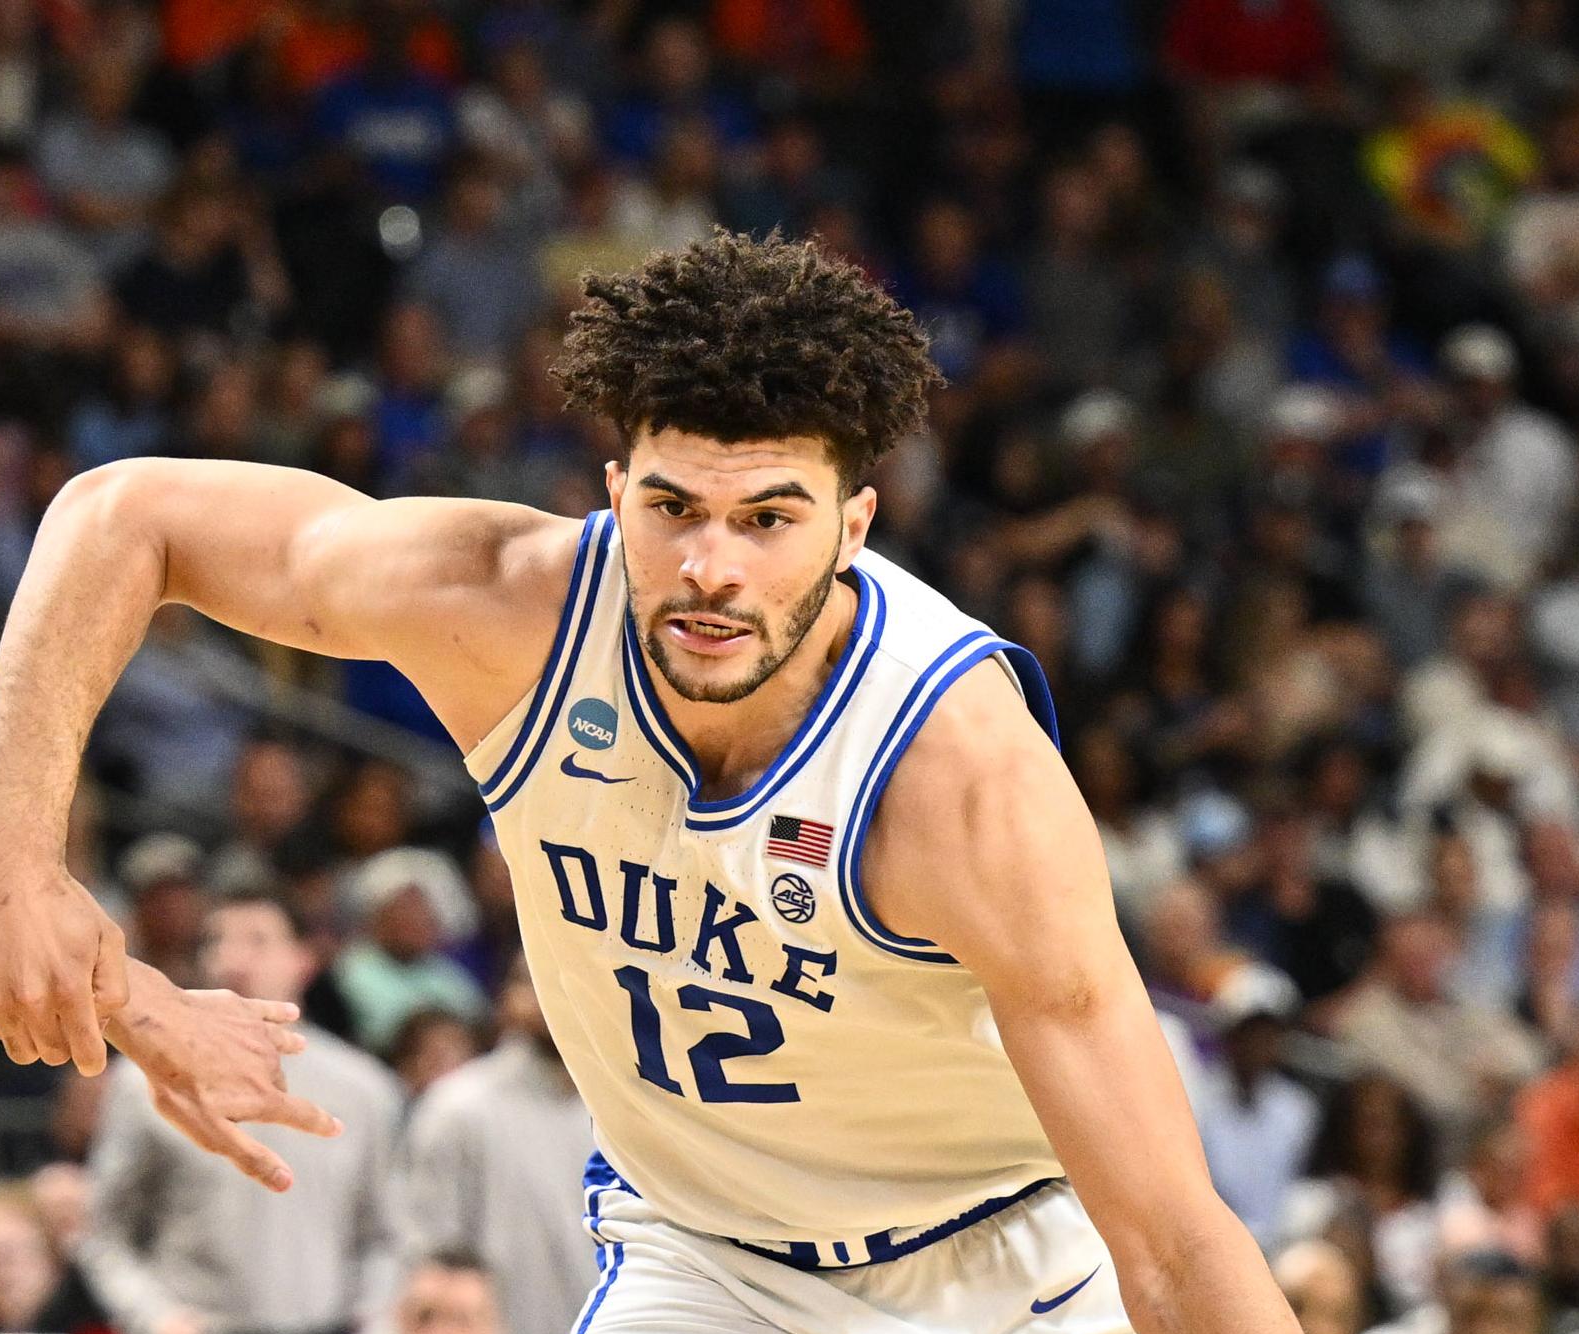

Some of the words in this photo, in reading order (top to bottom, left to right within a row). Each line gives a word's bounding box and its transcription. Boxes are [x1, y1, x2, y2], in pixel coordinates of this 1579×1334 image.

[571, 716, 615, 745] NCAA
[539, 839, 838, 1014] DUKE
[774, 888, 815, 910] ACC
[613, 964, 802, 1104] 12
